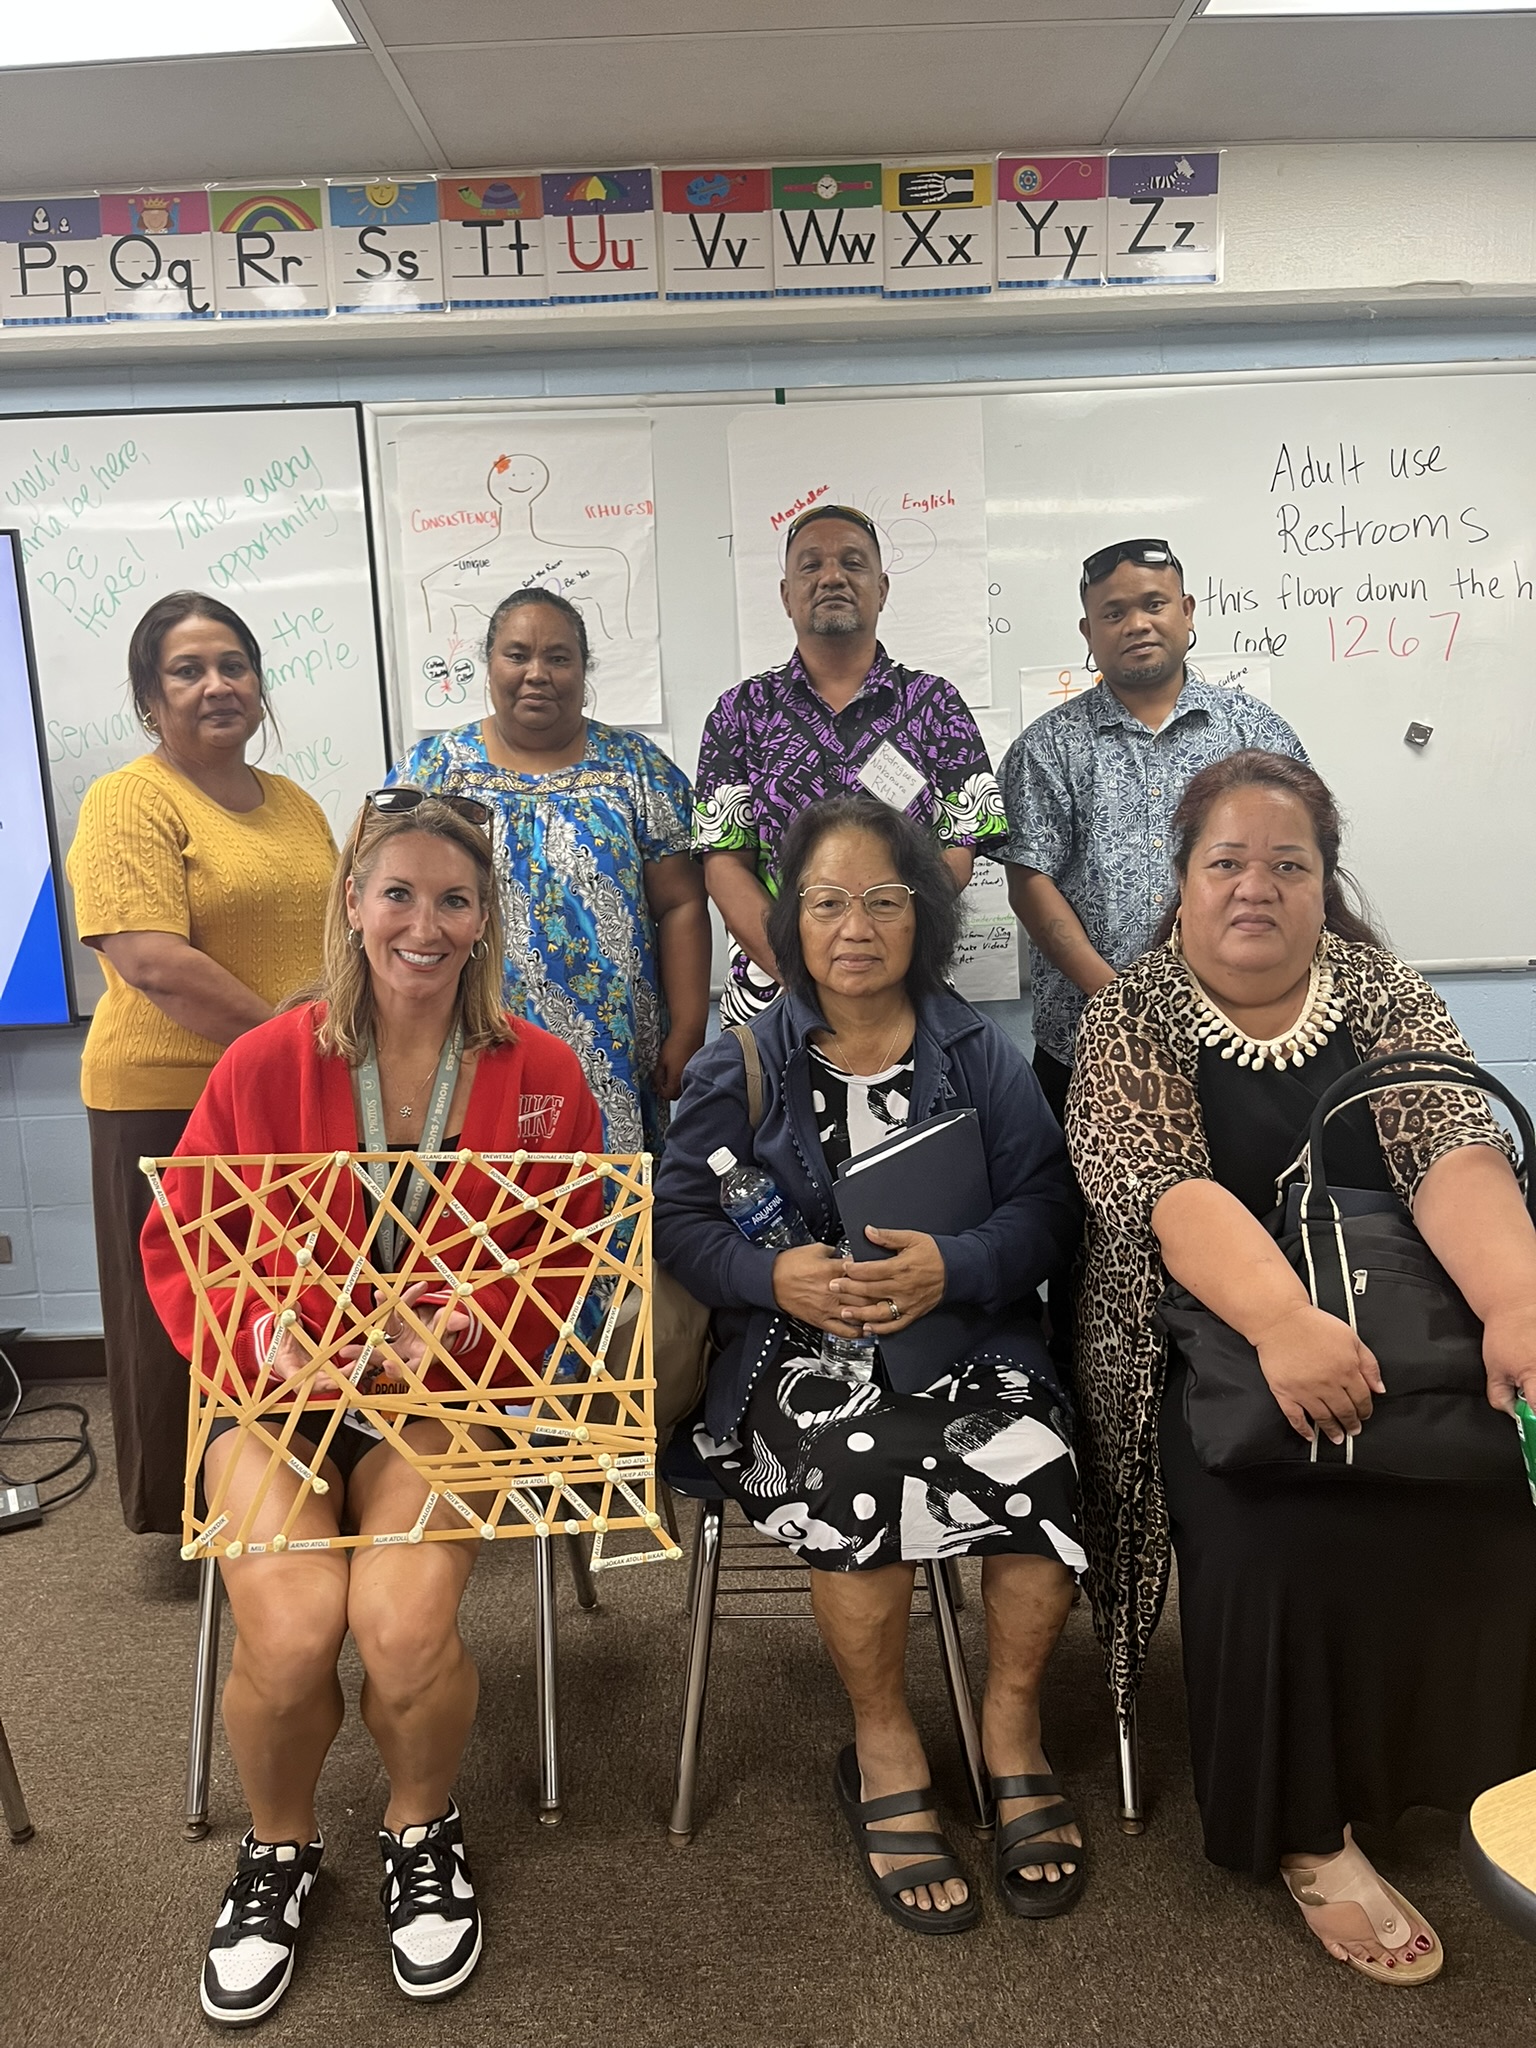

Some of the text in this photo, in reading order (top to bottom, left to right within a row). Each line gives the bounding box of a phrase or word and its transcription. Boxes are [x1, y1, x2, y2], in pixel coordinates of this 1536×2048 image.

[1270, 443, 1365, 492] Adult
[62, 484, 102, 518] be
[159, 445, 323, 549] Take every
[902, 490, 955, 513] English
[208, 494, 339, 593] opportunity
[1277, 503, 1489, 556] Restrooms
[37, 546, 98, 613] BE
[1200, 576, 1259, 616] this
[1277, 573, 1343, 610] floor
[1356, 573, 1428, 602] down
[1450, 568, 1504, 600] the
[272, 608, 334, 647] the
[1329, 612, 1460, 662] 1267
[434, 1082, 449, 1115] HOUSE
[409, 1178, 425, 1214] HOUSE
[751, 1195, 783, 1226] AQUAFINA
[289, 1540, 330, 1549] ARNO ATOLL
